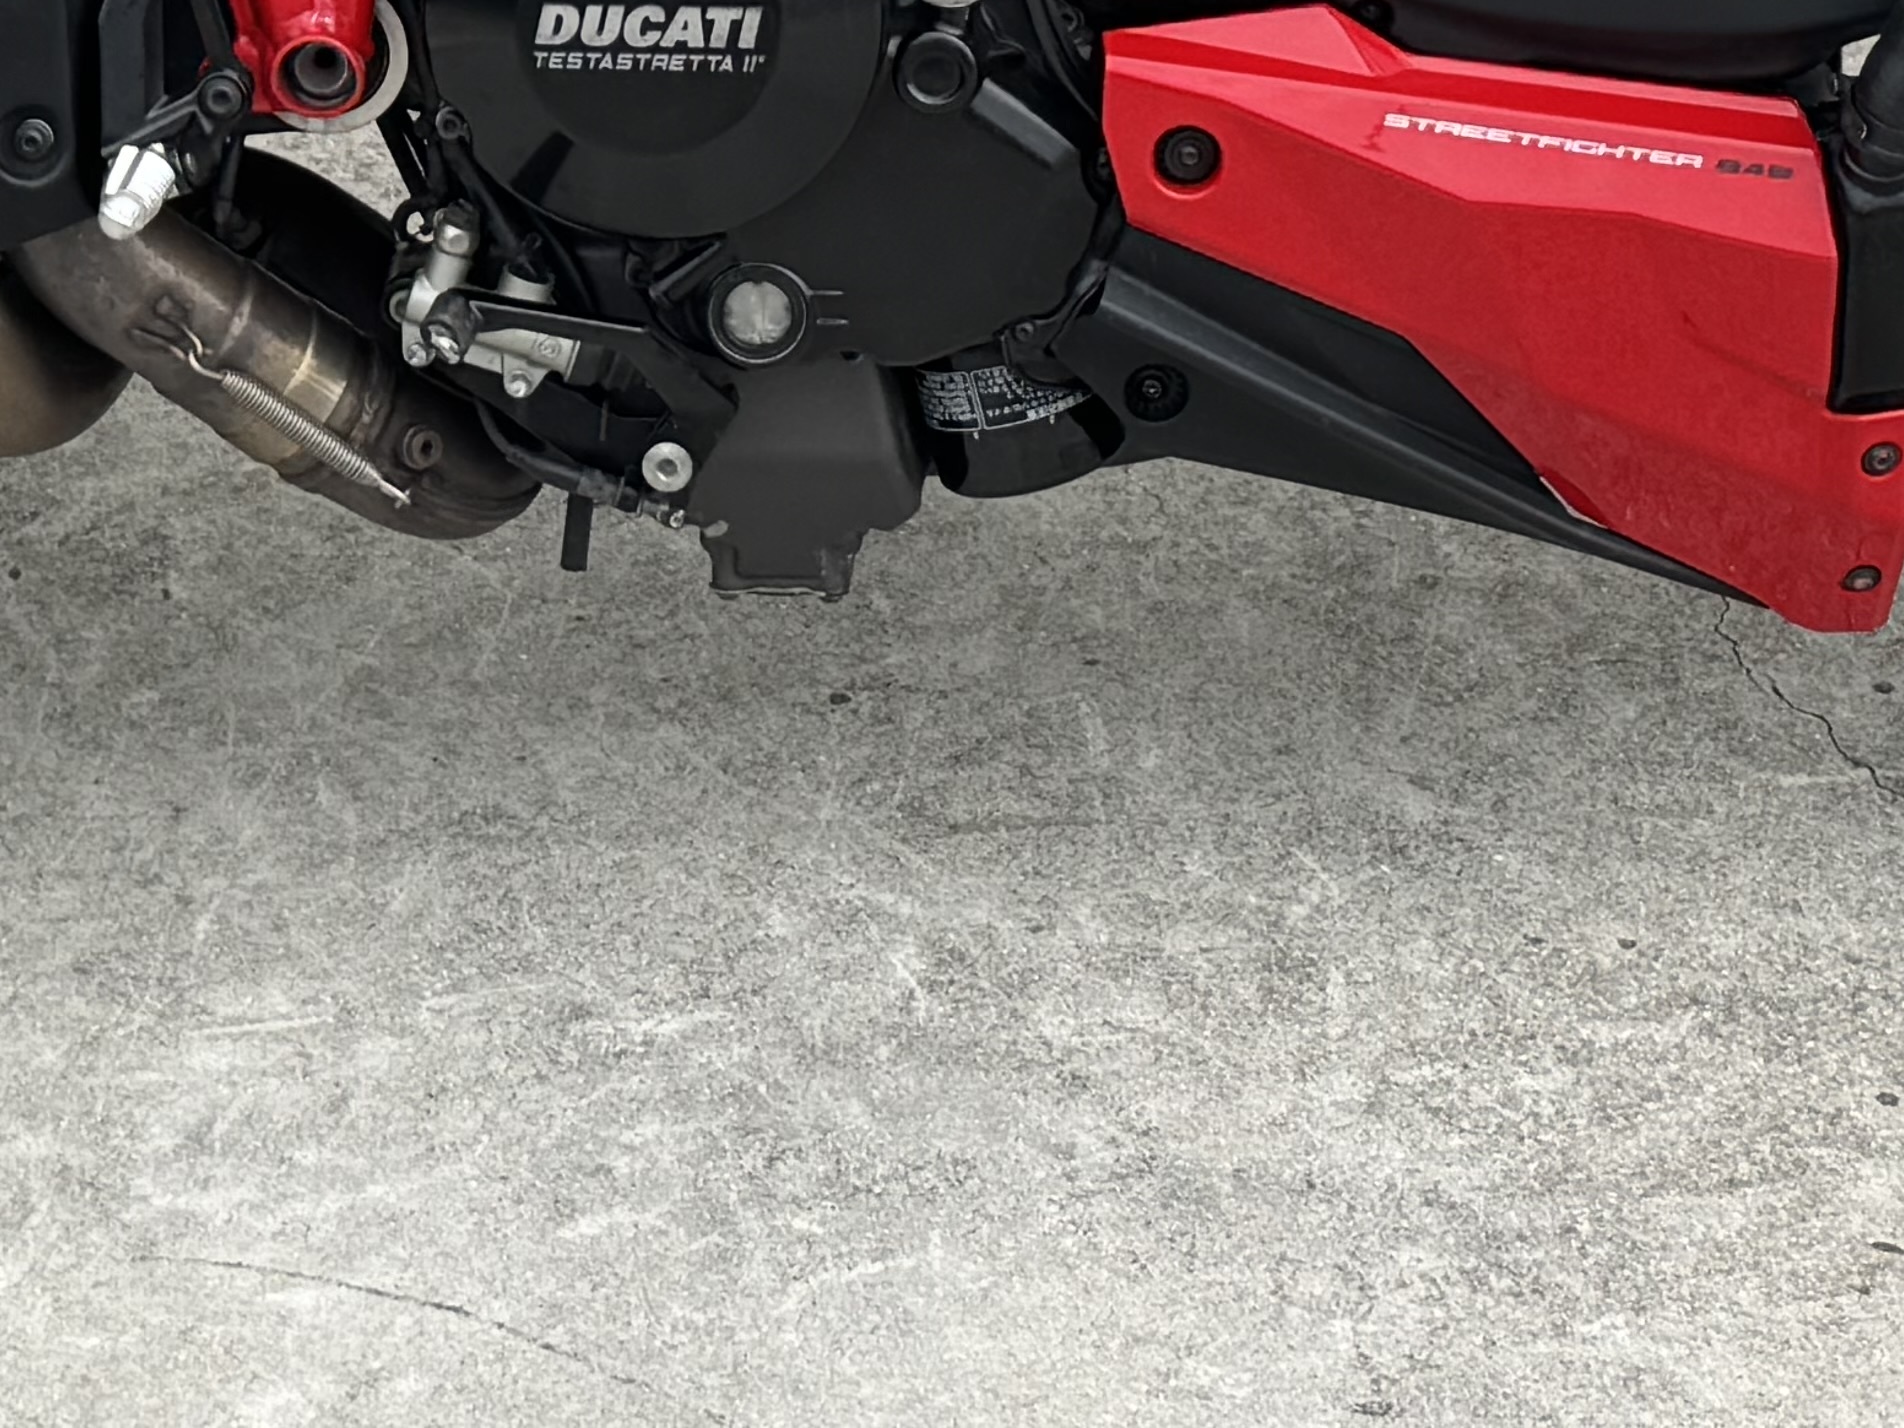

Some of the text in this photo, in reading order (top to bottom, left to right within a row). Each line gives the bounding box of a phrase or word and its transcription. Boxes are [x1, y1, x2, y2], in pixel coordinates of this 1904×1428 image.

[534, 2, 764, 50] DUCATI
[533, 50, 734, 73] TESTASTRETTA
[1383, 111, 1704, 170] STREETFIGHTER
